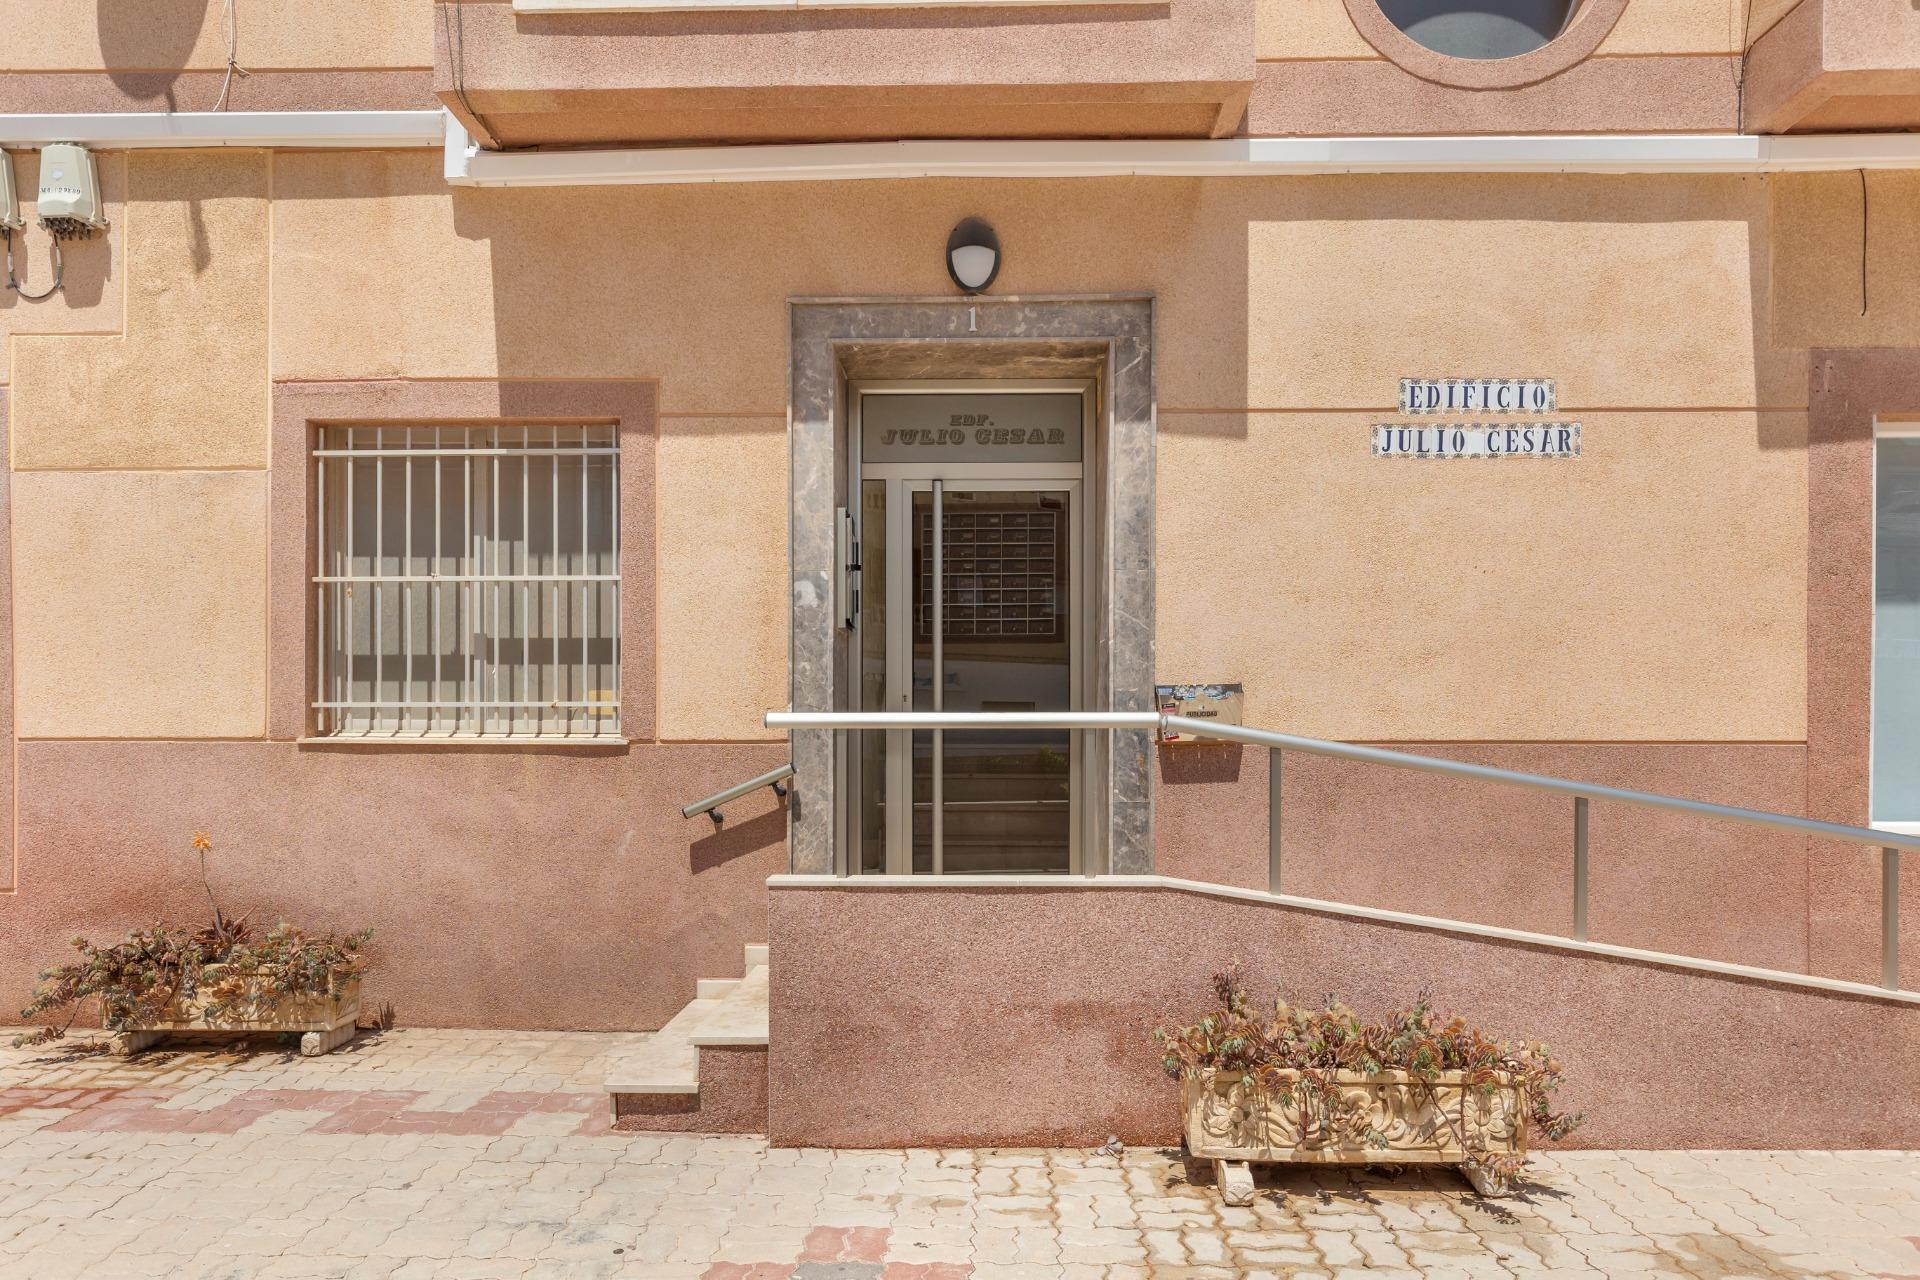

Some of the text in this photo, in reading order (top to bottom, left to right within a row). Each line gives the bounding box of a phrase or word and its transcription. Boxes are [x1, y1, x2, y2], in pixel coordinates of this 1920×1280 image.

[969, 306, 977, 331] 1
[1409, 385, 1546, 408] EDIFICIO
[950, 414, 994, 426] EDF.
[881, 428, 1065, 445] JULIO CESAR
[1382, 429, 1572, 453] JULIO CESAR
